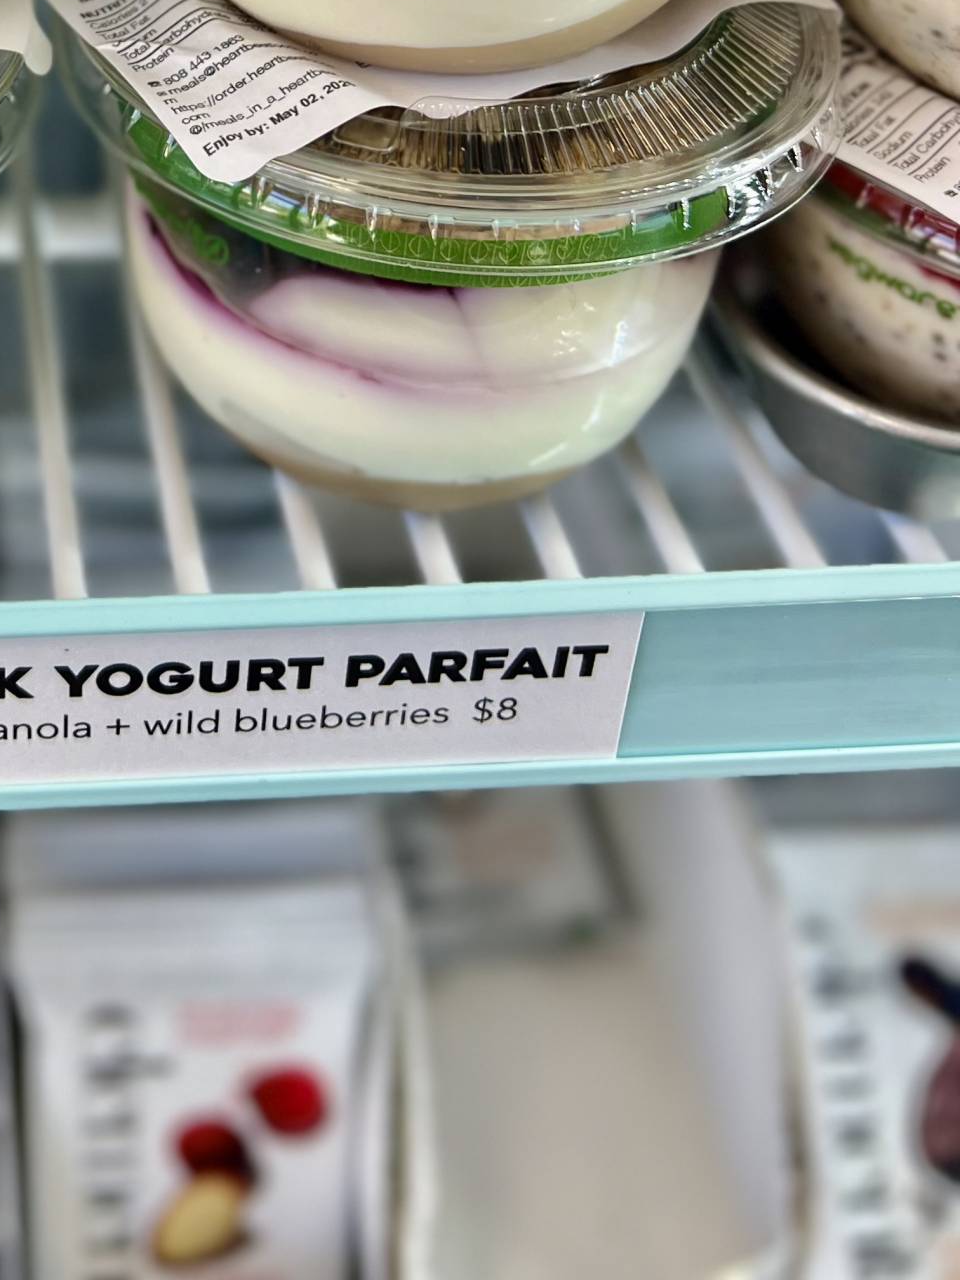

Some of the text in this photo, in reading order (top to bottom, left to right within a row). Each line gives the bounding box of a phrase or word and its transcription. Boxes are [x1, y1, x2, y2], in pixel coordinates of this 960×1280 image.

[101, 15, 151, 41] Total Fat
[120, 41, 151, 62] Total
[132, 47, 175, 72] Protein
[163, 69, 189, 86] 808
[190, 51, 212, 71] 443
[203, 79, 356, 157] Enjoy by: May 02, 202
[913, 155, 952, 183] Protein
[54, 656, 325, 699] YOGURT
[344, 643, 611, 688] PARFAIT
[105, 717, 132, 738] +
[143, 710, 220, 737] wild
[235, 702, 451, 733] blueberries
[472, 696, 519, 725] $8
